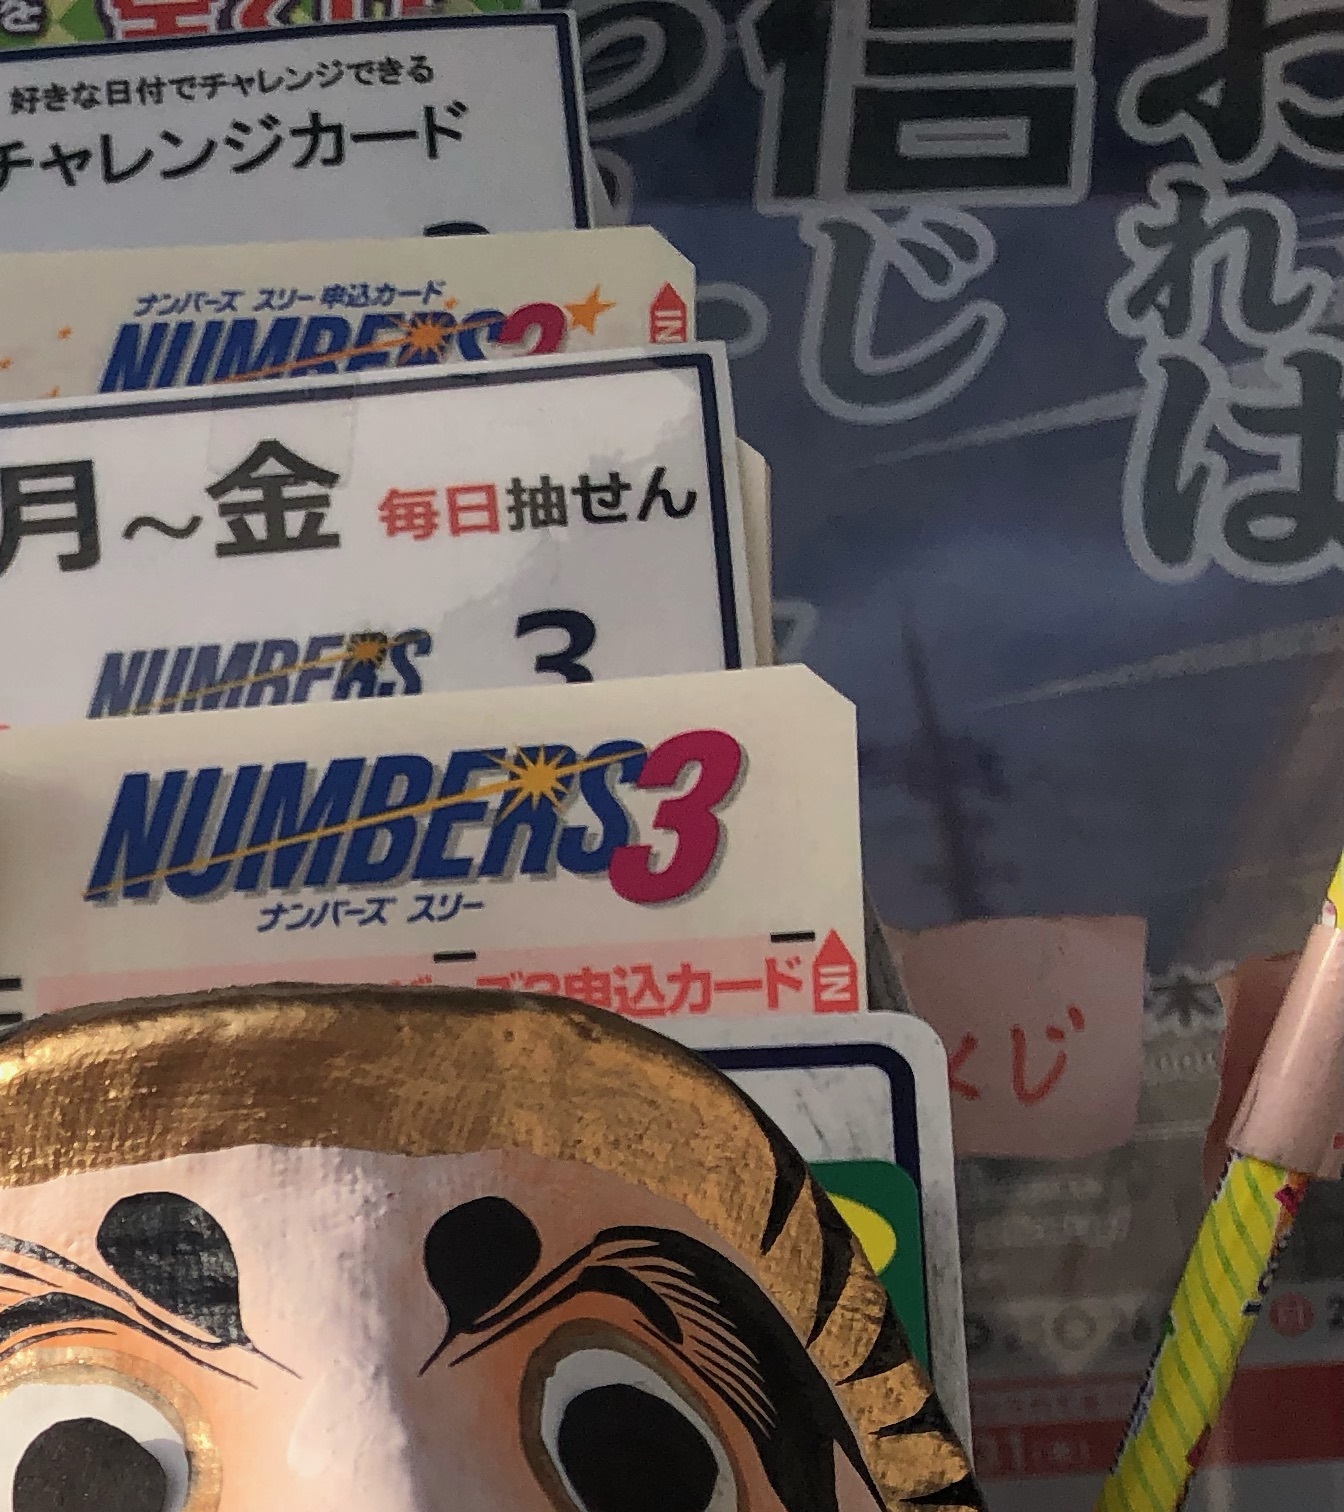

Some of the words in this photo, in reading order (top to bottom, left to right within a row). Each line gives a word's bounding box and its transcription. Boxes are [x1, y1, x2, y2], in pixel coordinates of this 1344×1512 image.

[10, 56, 434, 114] 好きな日付でチャレンジできる
[378, 467, 698, 541] 毎日抽せん
[84, 739, 649, 907] NUMBERS
[608, 730, 749, 906] 3
[257, 897, 387, 934] ナンバーズ
[410, 891, 485, 922] スリー
